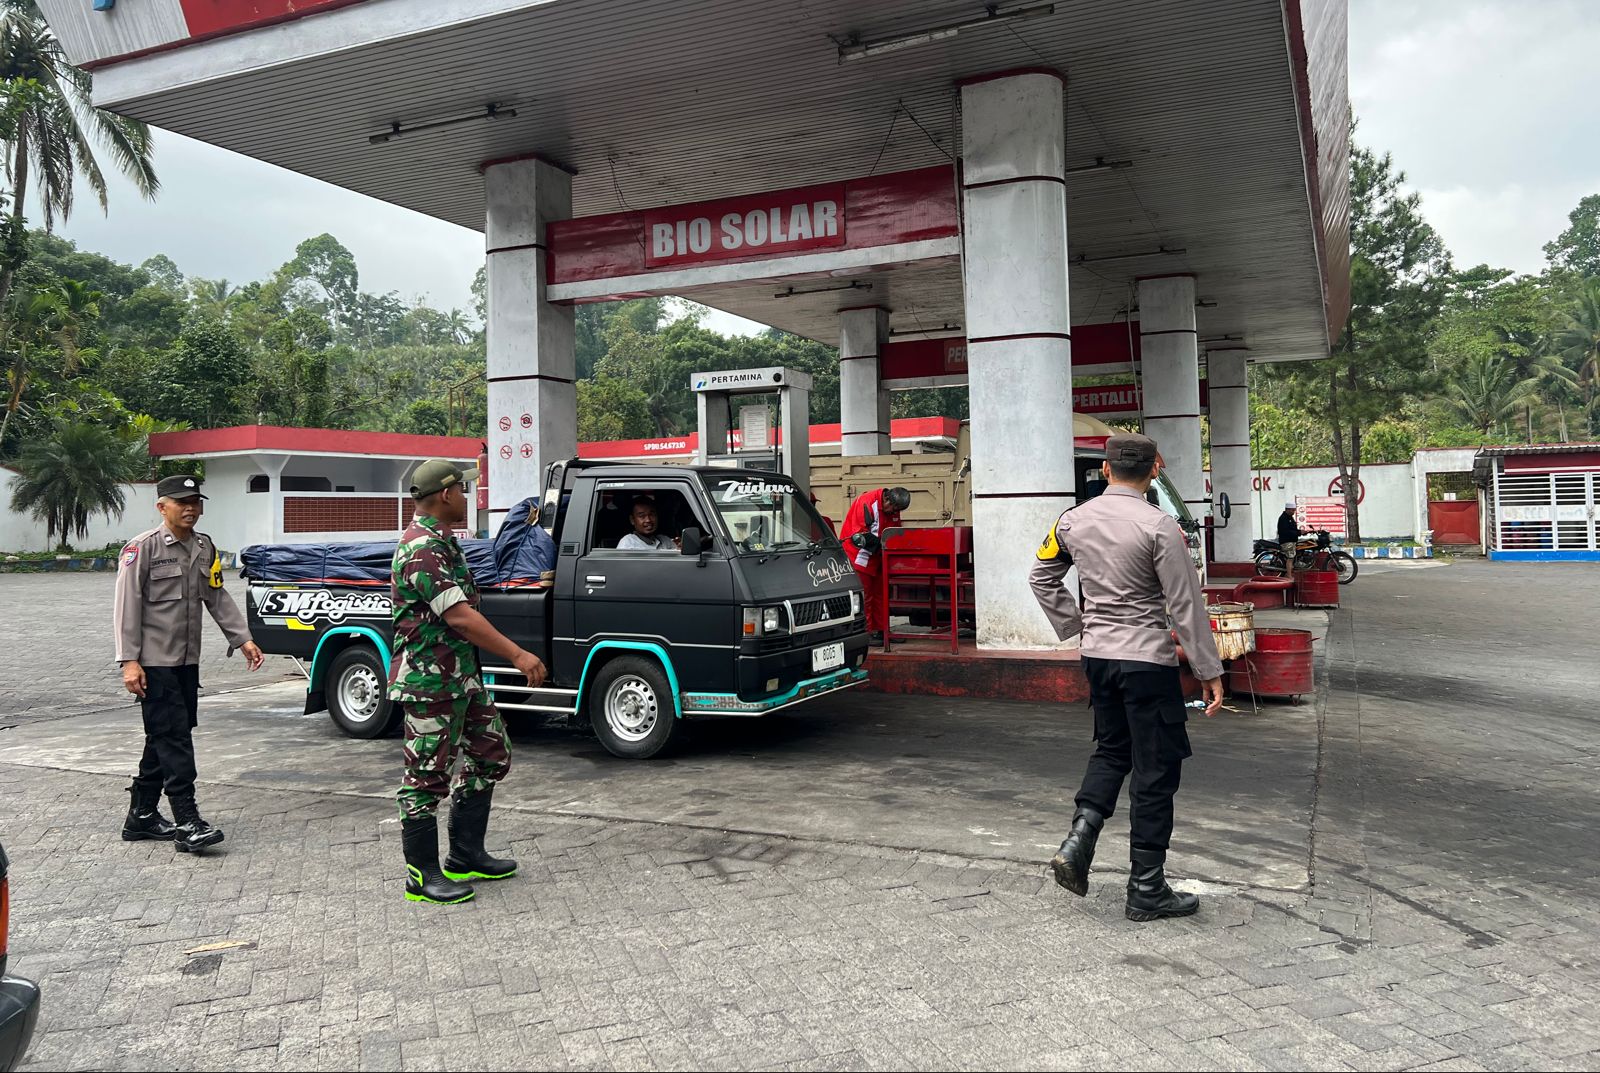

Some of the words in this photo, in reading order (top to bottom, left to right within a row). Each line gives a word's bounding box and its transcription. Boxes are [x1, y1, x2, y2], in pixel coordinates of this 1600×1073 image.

[653, 217, 712, 258] BIO
[720, 200, 838, 249] SOLAR
[711, 373, 763, 384] PERTAMINA
